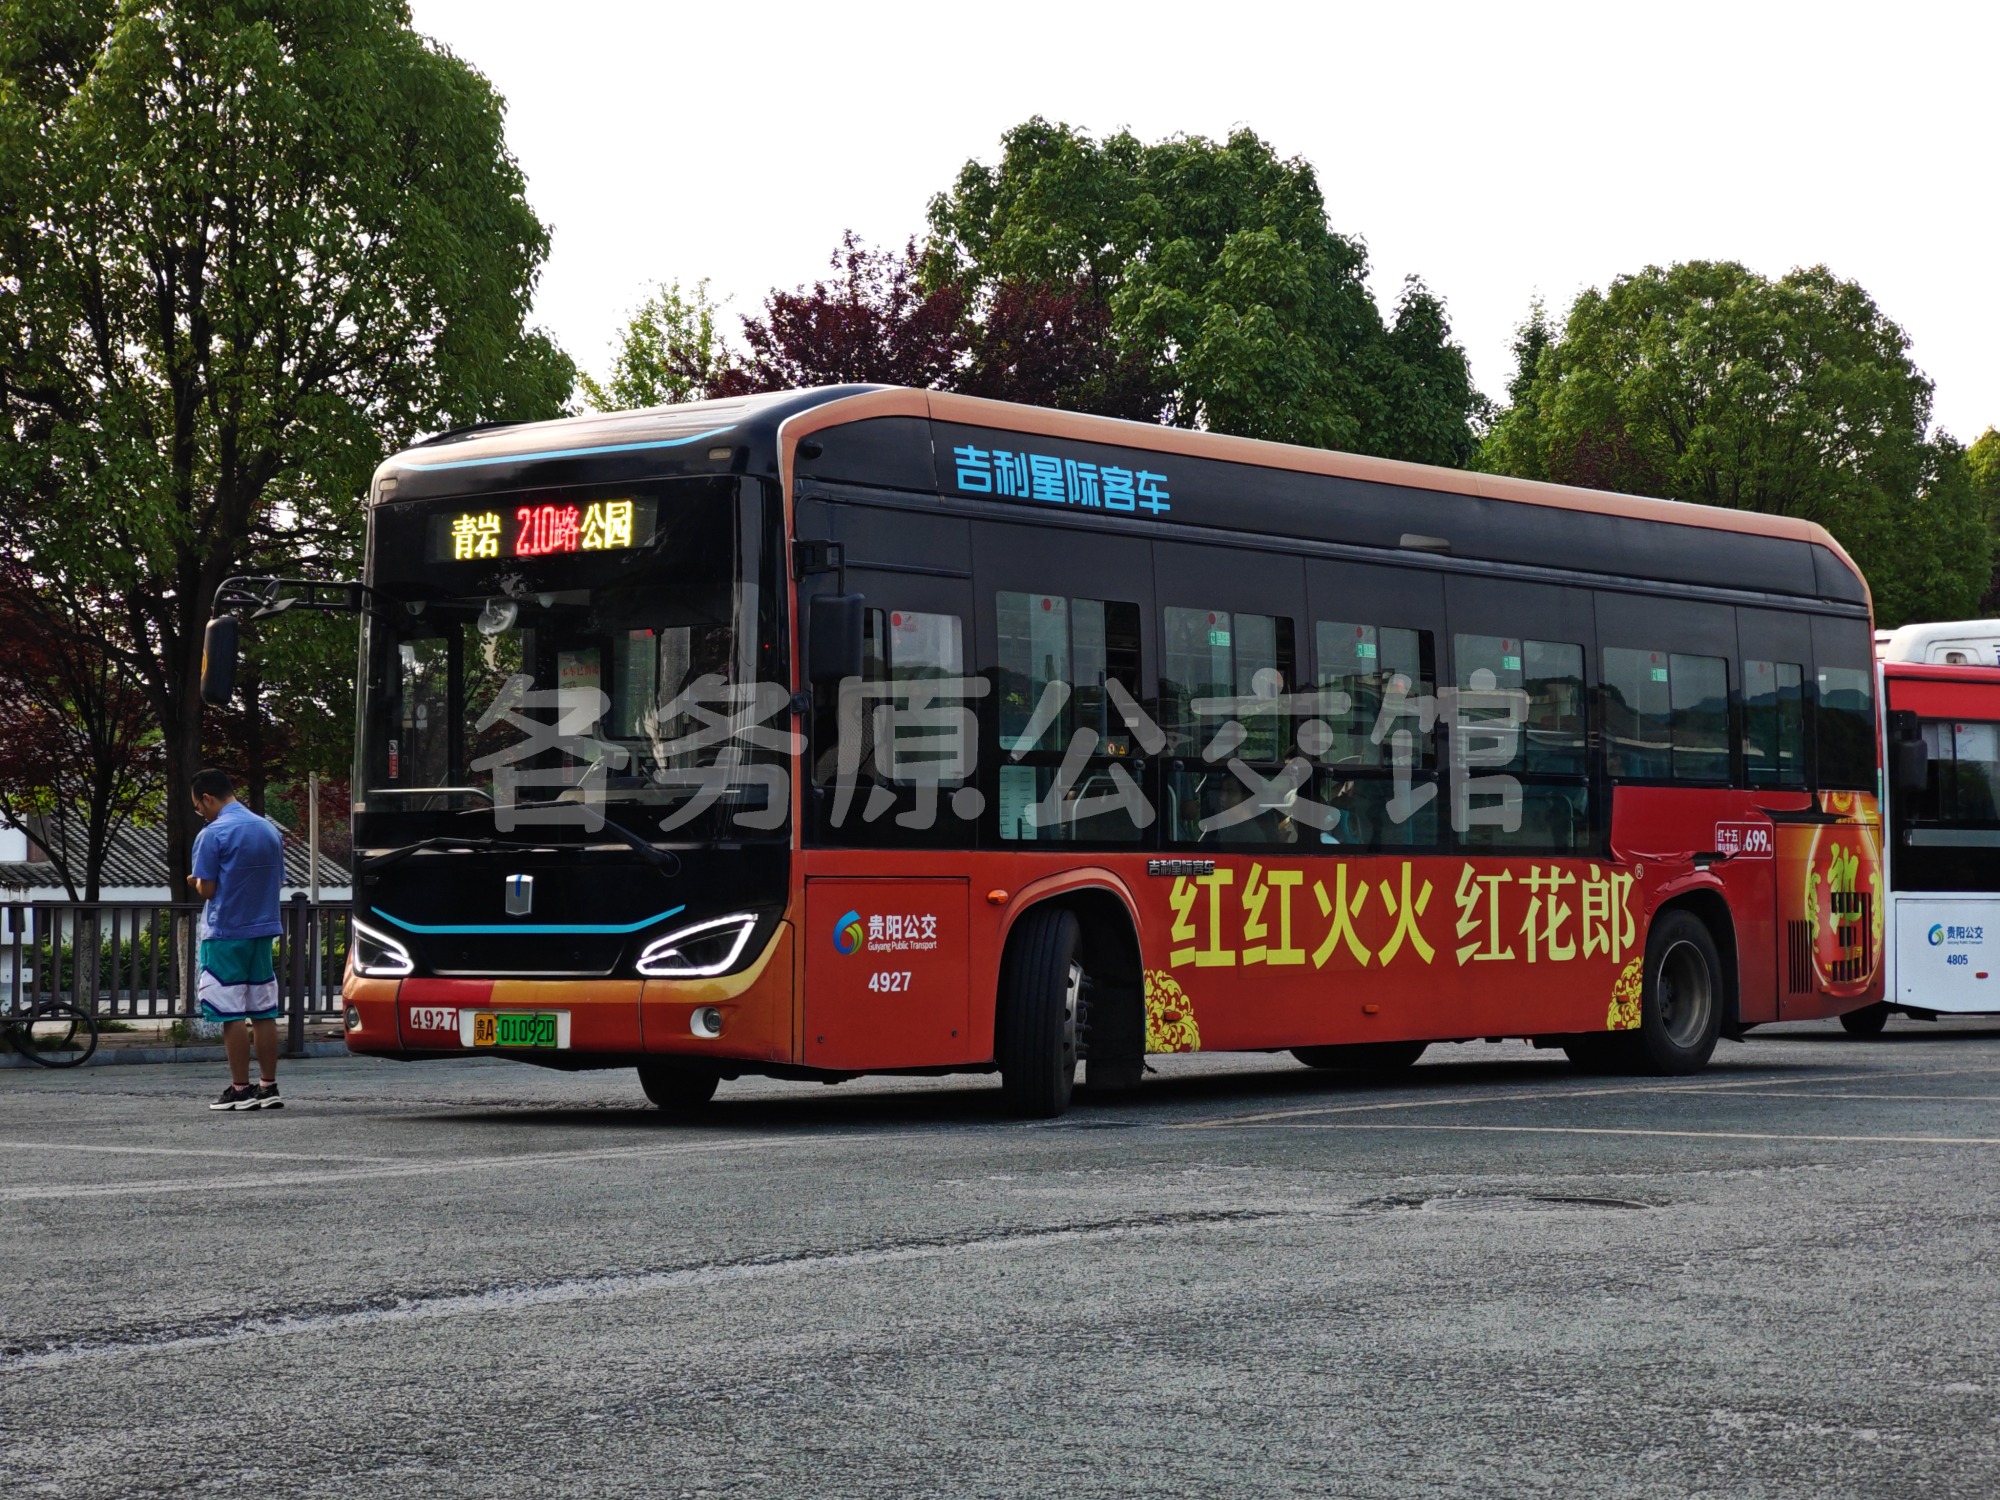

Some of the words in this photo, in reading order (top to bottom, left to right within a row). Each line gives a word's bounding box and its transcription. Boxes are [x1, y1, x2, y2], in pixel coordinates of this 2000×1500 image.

[953, 445, 1171, 514] 吉利星际客车
[452, 512, 500, 559] 青岩
[516, 504, 580, 556] 210路
[581, 500, 633, 549] 公园
[1717, 828, 1739, 842] 红十五
[1169, 862, 1436, 969] 红红火火
[1455, 861, 1637, 967] 红花郎
[868, 913, 937, 940] 贵阳公交
[1947, 925, 1984, 939] 贵阳公交
[867, 941, 892, 953] Guiyang
[891, 940, 909, 951] Public
[910, 940, 937, 952] Transport
[1946, 954, 1969, 965] 4805
[868, 971, 912, 992] 4927
[412, 1009, 457, 1031] 4927
